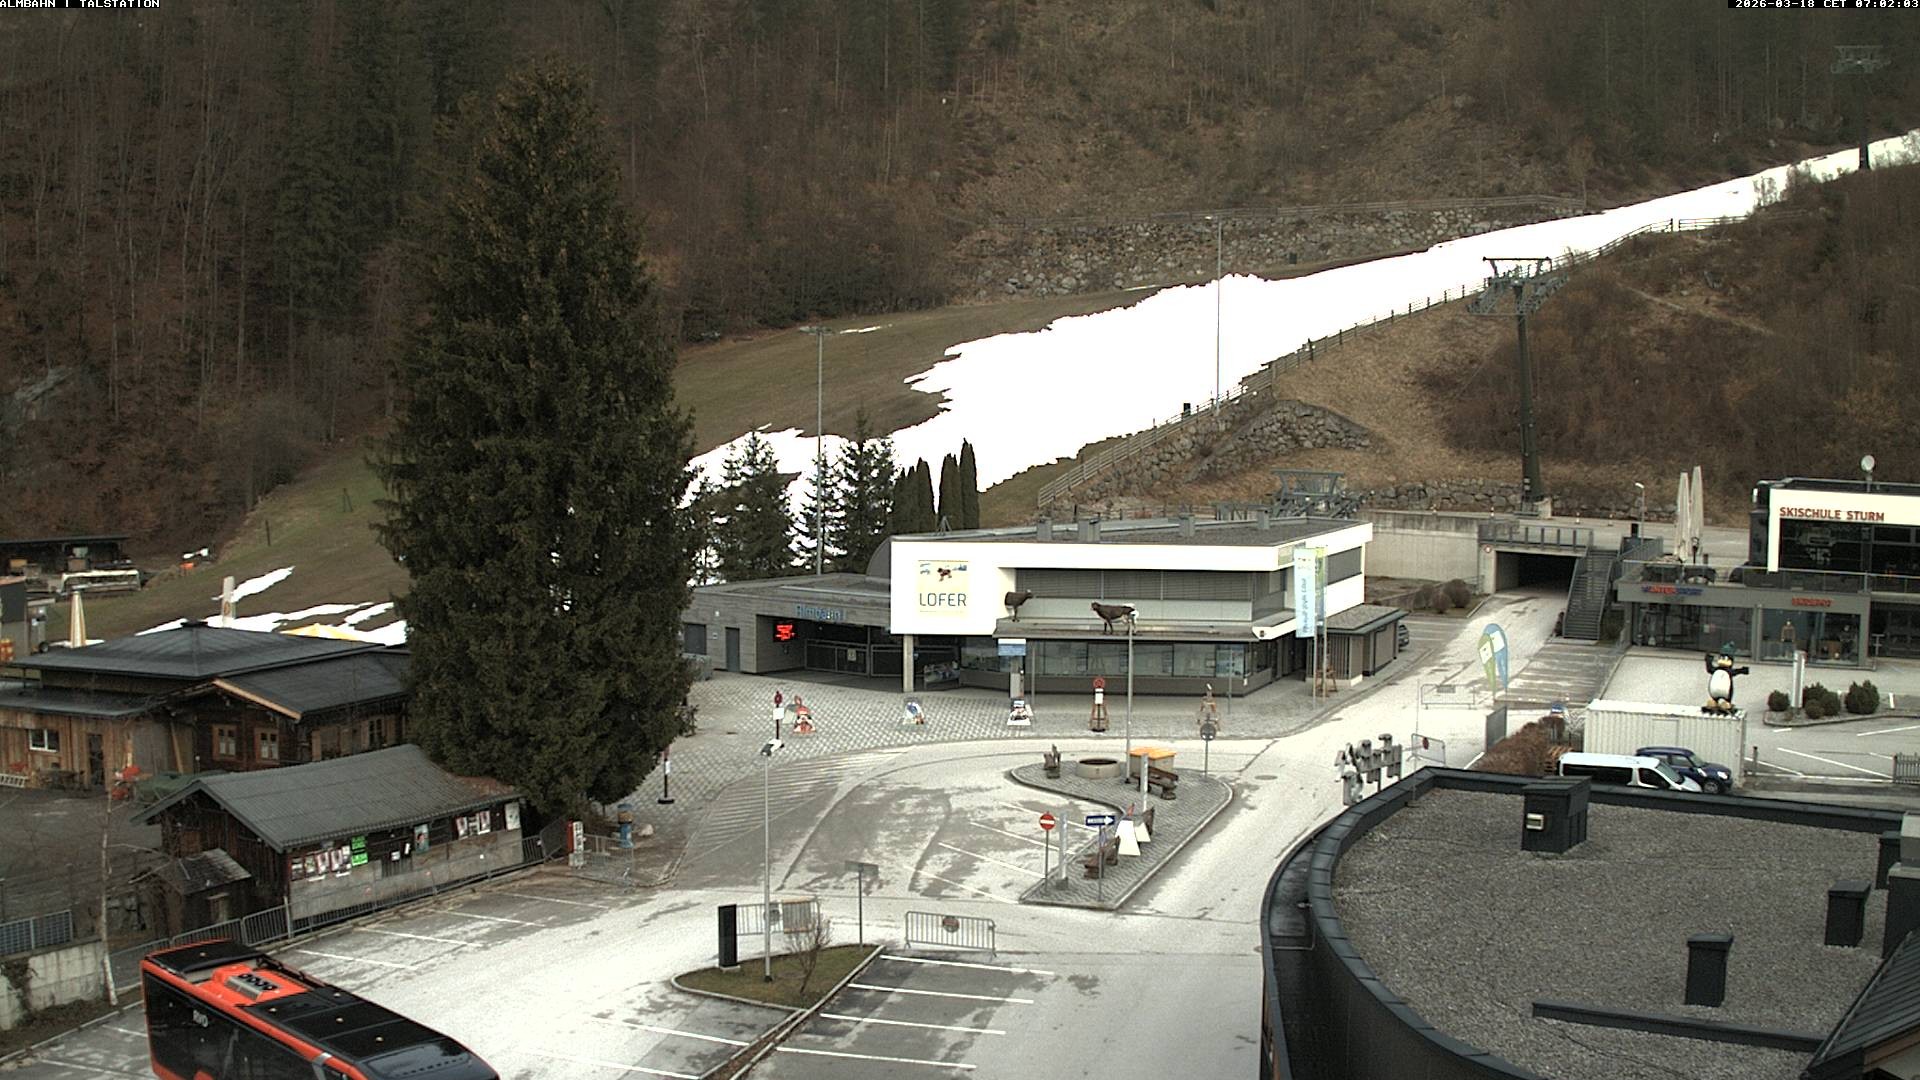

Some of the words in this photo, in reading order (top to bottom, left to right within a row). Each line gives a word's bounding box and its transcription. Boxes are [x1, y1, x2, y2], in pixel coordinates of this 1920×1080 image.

[1780, 507, 1841, 520] SKISCHULE
[1846, 511, 1885, 522] STURM
[919, 592, 967, 607] LOFER
